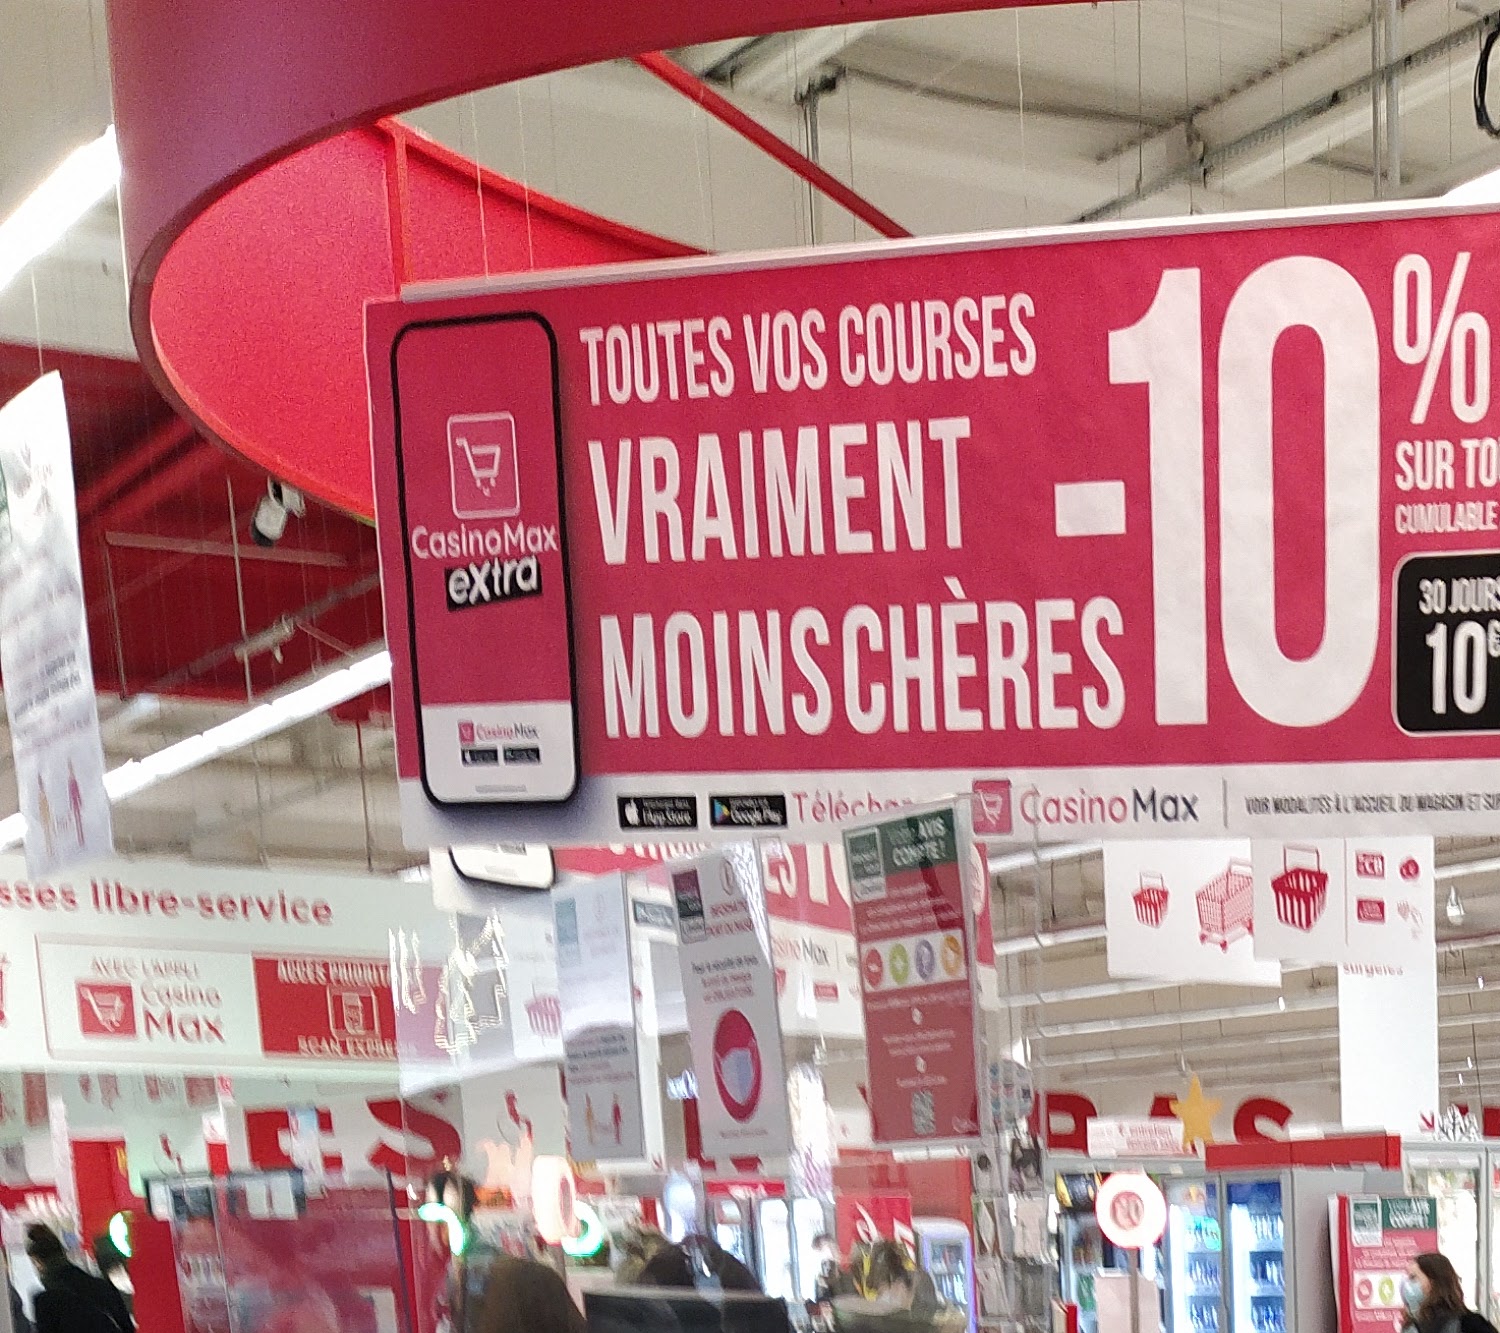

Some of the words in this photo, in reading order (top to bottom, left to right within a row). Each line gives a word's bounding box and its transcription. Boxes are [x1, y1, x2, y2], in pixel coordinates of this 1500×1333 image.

[580, 316, 733, 405] TOUTES
[744, 307, 831, 394] VOS
[839, 293, 1037, 387] COURSES
[1395, 439, 1454, 491] SUR
[588, 417, 970, 565] VRAIMENT
[1395, 501, 1499, 534] CUMULABLE
[448, 555, 539, 604] extra
[1419, 577, 1447, 615] 30
[600, 606, 832, 739] MOINS
[842, 576, 1126, 732] CHÈRES
[90, 876, 334, 926] libre-service
[140, 979, 224, 1009] Casino
[143, 1006, 227, 1044] Max
